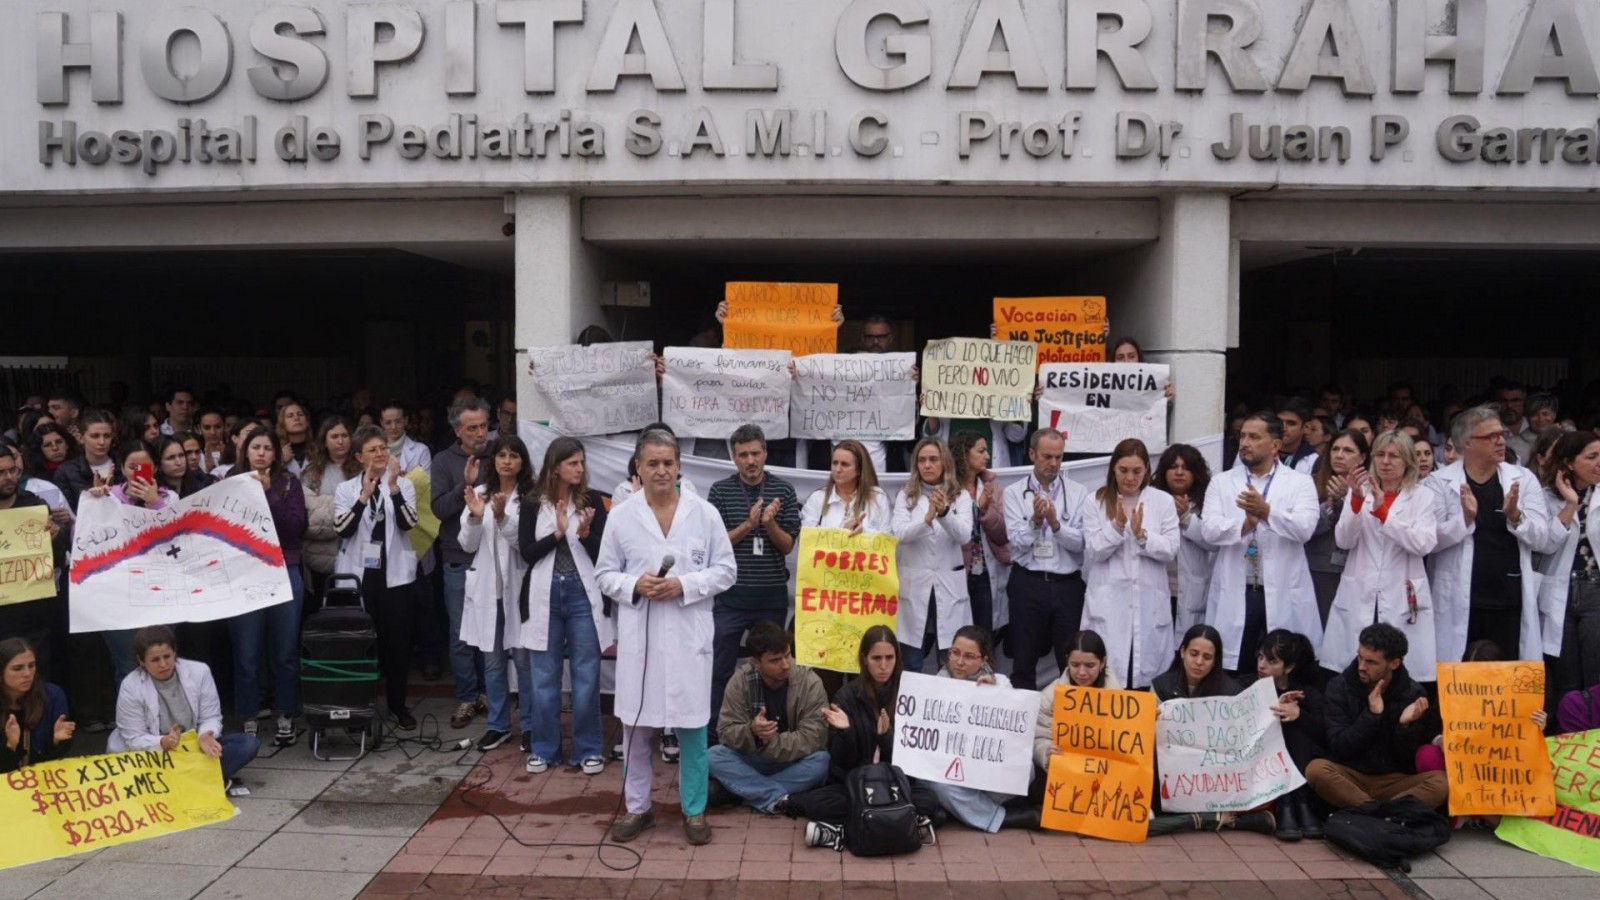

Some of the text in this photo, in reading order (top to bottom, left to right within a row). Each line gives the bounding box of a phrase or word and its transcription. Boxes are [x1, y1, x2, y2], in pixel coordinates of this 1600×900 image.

[36, 0, 780, 105] HOSPITAL
[38, 115, 258, 175] Hospital
[275, 115, 341, 163] de
[1211, 112, 1351, 162] Juan
[1436, 114, 1600, 164] Garra
[927, 341, 956, 361] AMO
[962, 342, 978, 362] LO
[980, 342, 1002, 363] QUE
[1038, 347, 1101, 363] plotación
[938, 365, 970, 386] PERO
[971, 367, 990, 387] NO
[1046, 367, 1158, 391] RESIDENCIA
[811, 384, 873, 405] NO HAY
[925, 389, 948, 412] CON
[951, 392, 968, 415] LO
[971, 394, 996, 418] QUE
[1085, 393, 1111, 409] EN
[803, 409, 890, 431] HOSPITAL
[812, 549, 889, 575] POBRES
[801, 587, 898, 616] ENFERMO
[897, 694, 916, 717] 80
[1063, 688, 1140, 720] SALUD
[1481, 698, 1519, 718] MAL
[900, 722, 940, 752] $3000
[1056, 722, 1145, 756] PÚBLICA
[1166, 728, 1196, 749] NO
[1491, 723, 1526, 740] MAL
[1084, 758, 1108, 775] EN
[1488, 747, 1525, 763] MAL
[7, 768, 39, 791] 68
[42, 768, 70, 790] HS
[94, 750, 175, 781] SEMANA
[1048, 778, 1148, 824] LLAMAS
